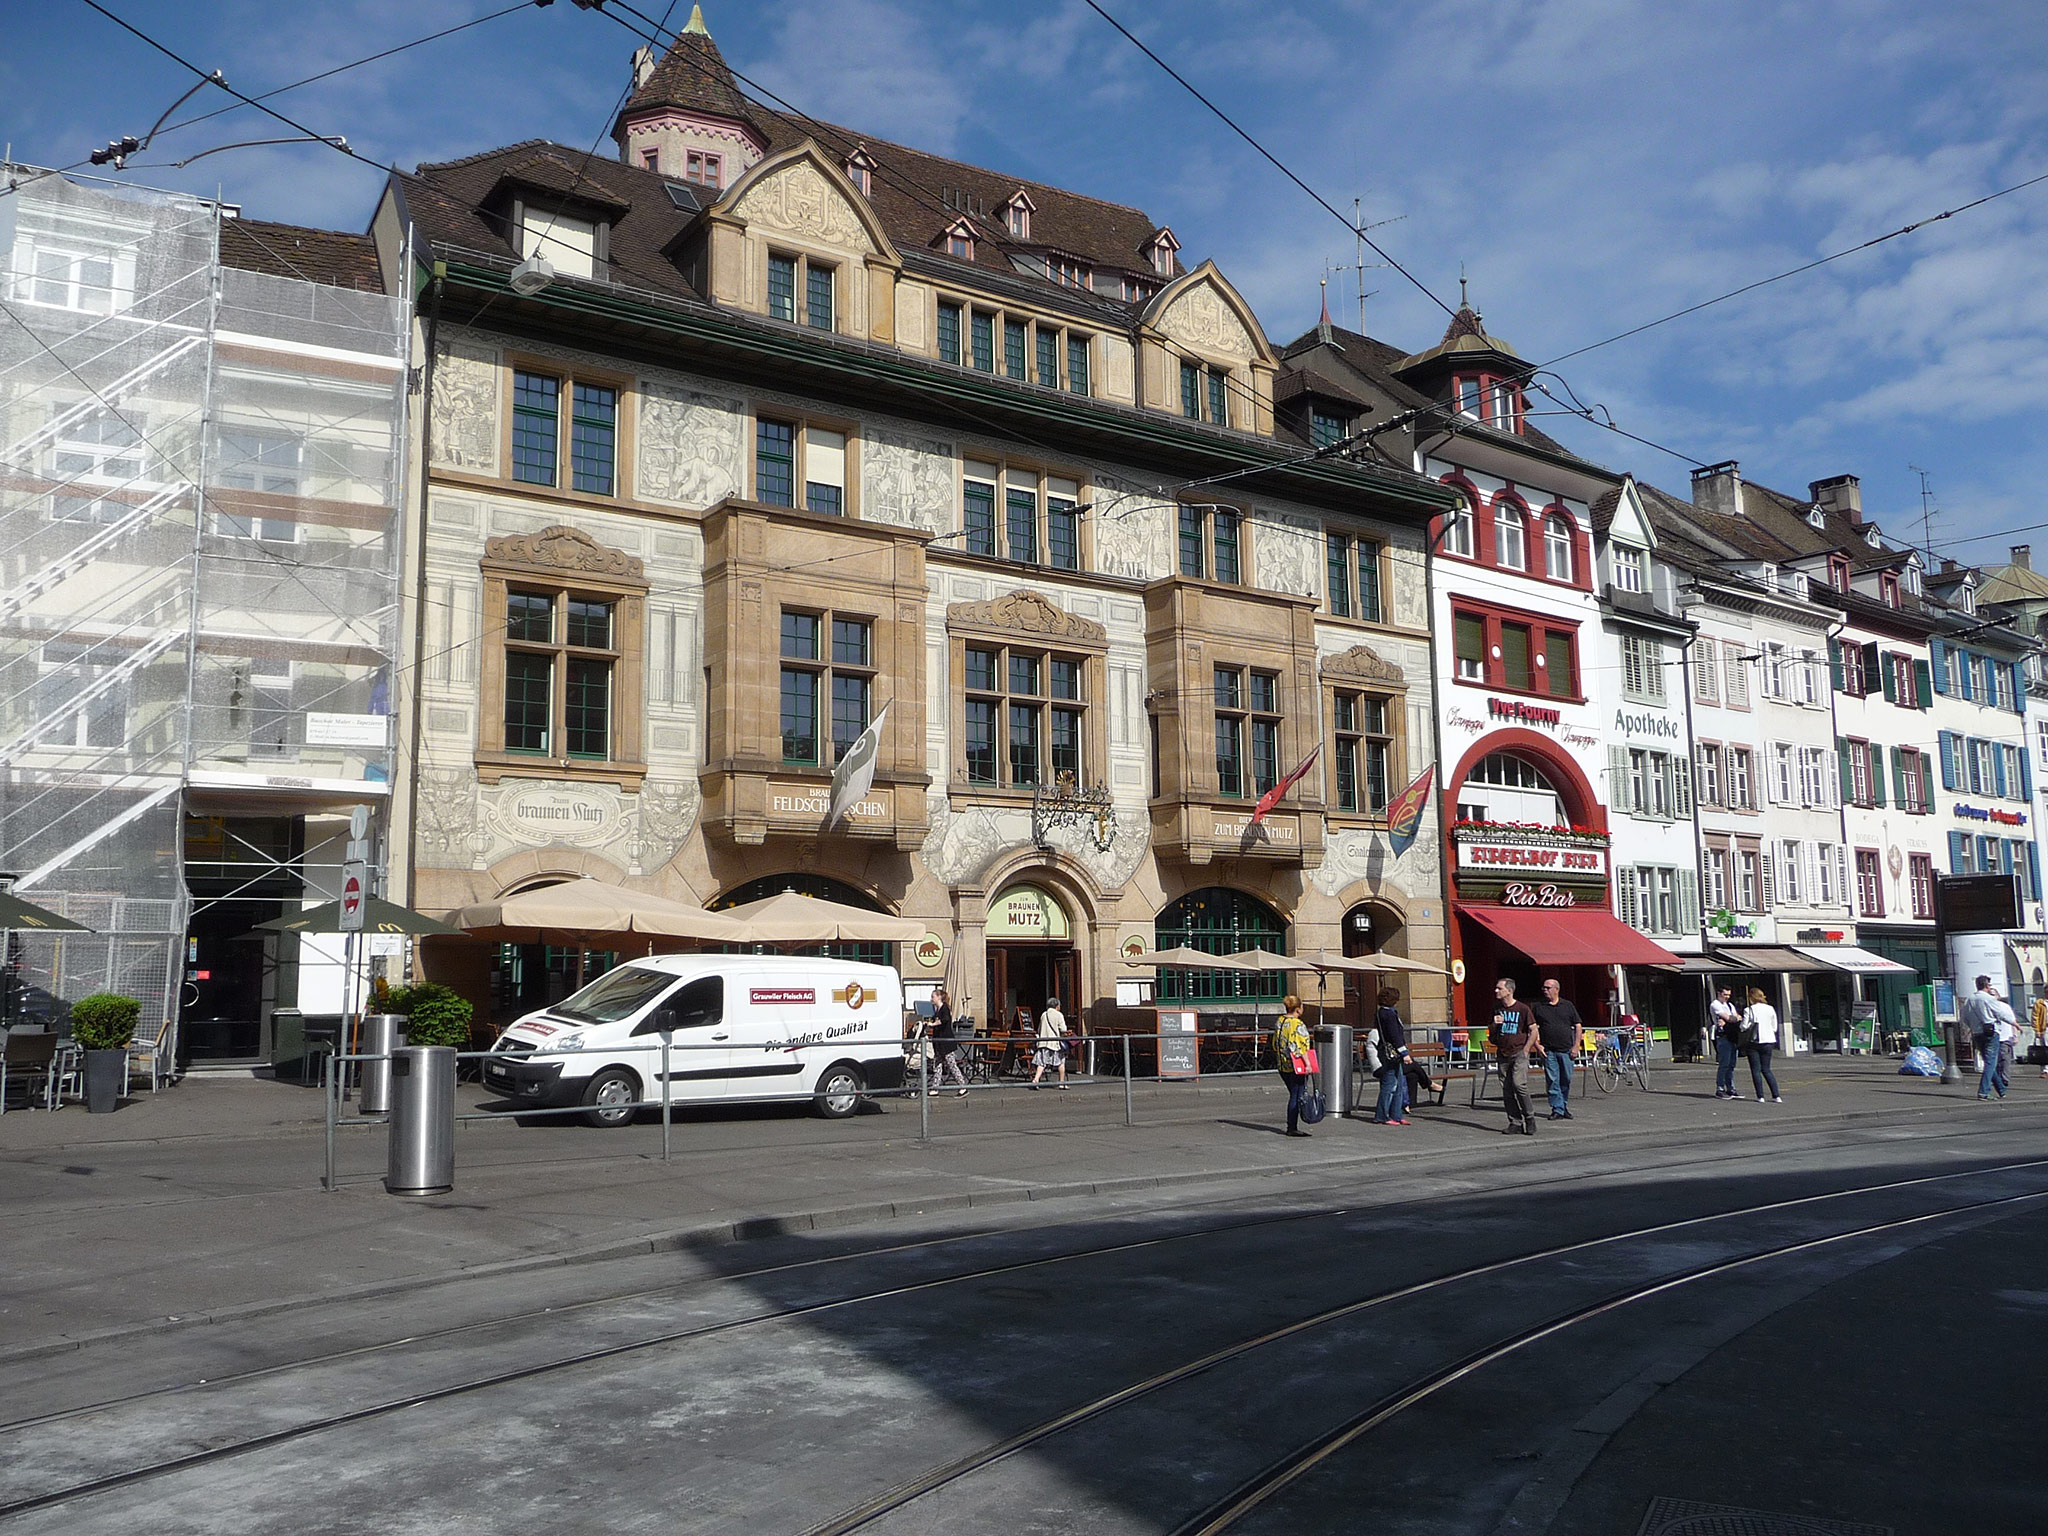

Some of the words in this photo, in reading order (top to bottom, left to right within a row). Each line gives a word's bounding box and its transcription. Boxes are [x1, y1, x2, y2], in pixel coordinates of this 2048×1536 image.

[1489, 698, 1515, 717] Vve
[1516, 702, 1561, 725] Fourny
[1614, 708, 1679, 739] Apotheke
[517, 799, 570, 820] braunen
[772, 796, 886, 817] FELDSCHSCHEN
[1214, 823, 1232, 836] ZUM
[1233, 824, 1271, 838] BRAUNEN
[1272, 827, 1294, 839] MUTZ
[1855, 832, 1881, 844] BODEGA
[1471, 847, 1559, 866] ZIEGELHOF
[1562, 852, 1599, 868] BIER
[1504, 883, 1538, 906] Rio
[1538, 884, 1575, 907] Bar
[1007, 902, 1041, 911] BRAUNEN
[1008, 912, 1041, 926] MUTZ
[752, 992, 782, 1000] Grauwiler
[783, 992, 803, 1000] Fleisch
[785, 1031, 823, 1046] andere
[826, 1020, 869, 1039] Qualität
